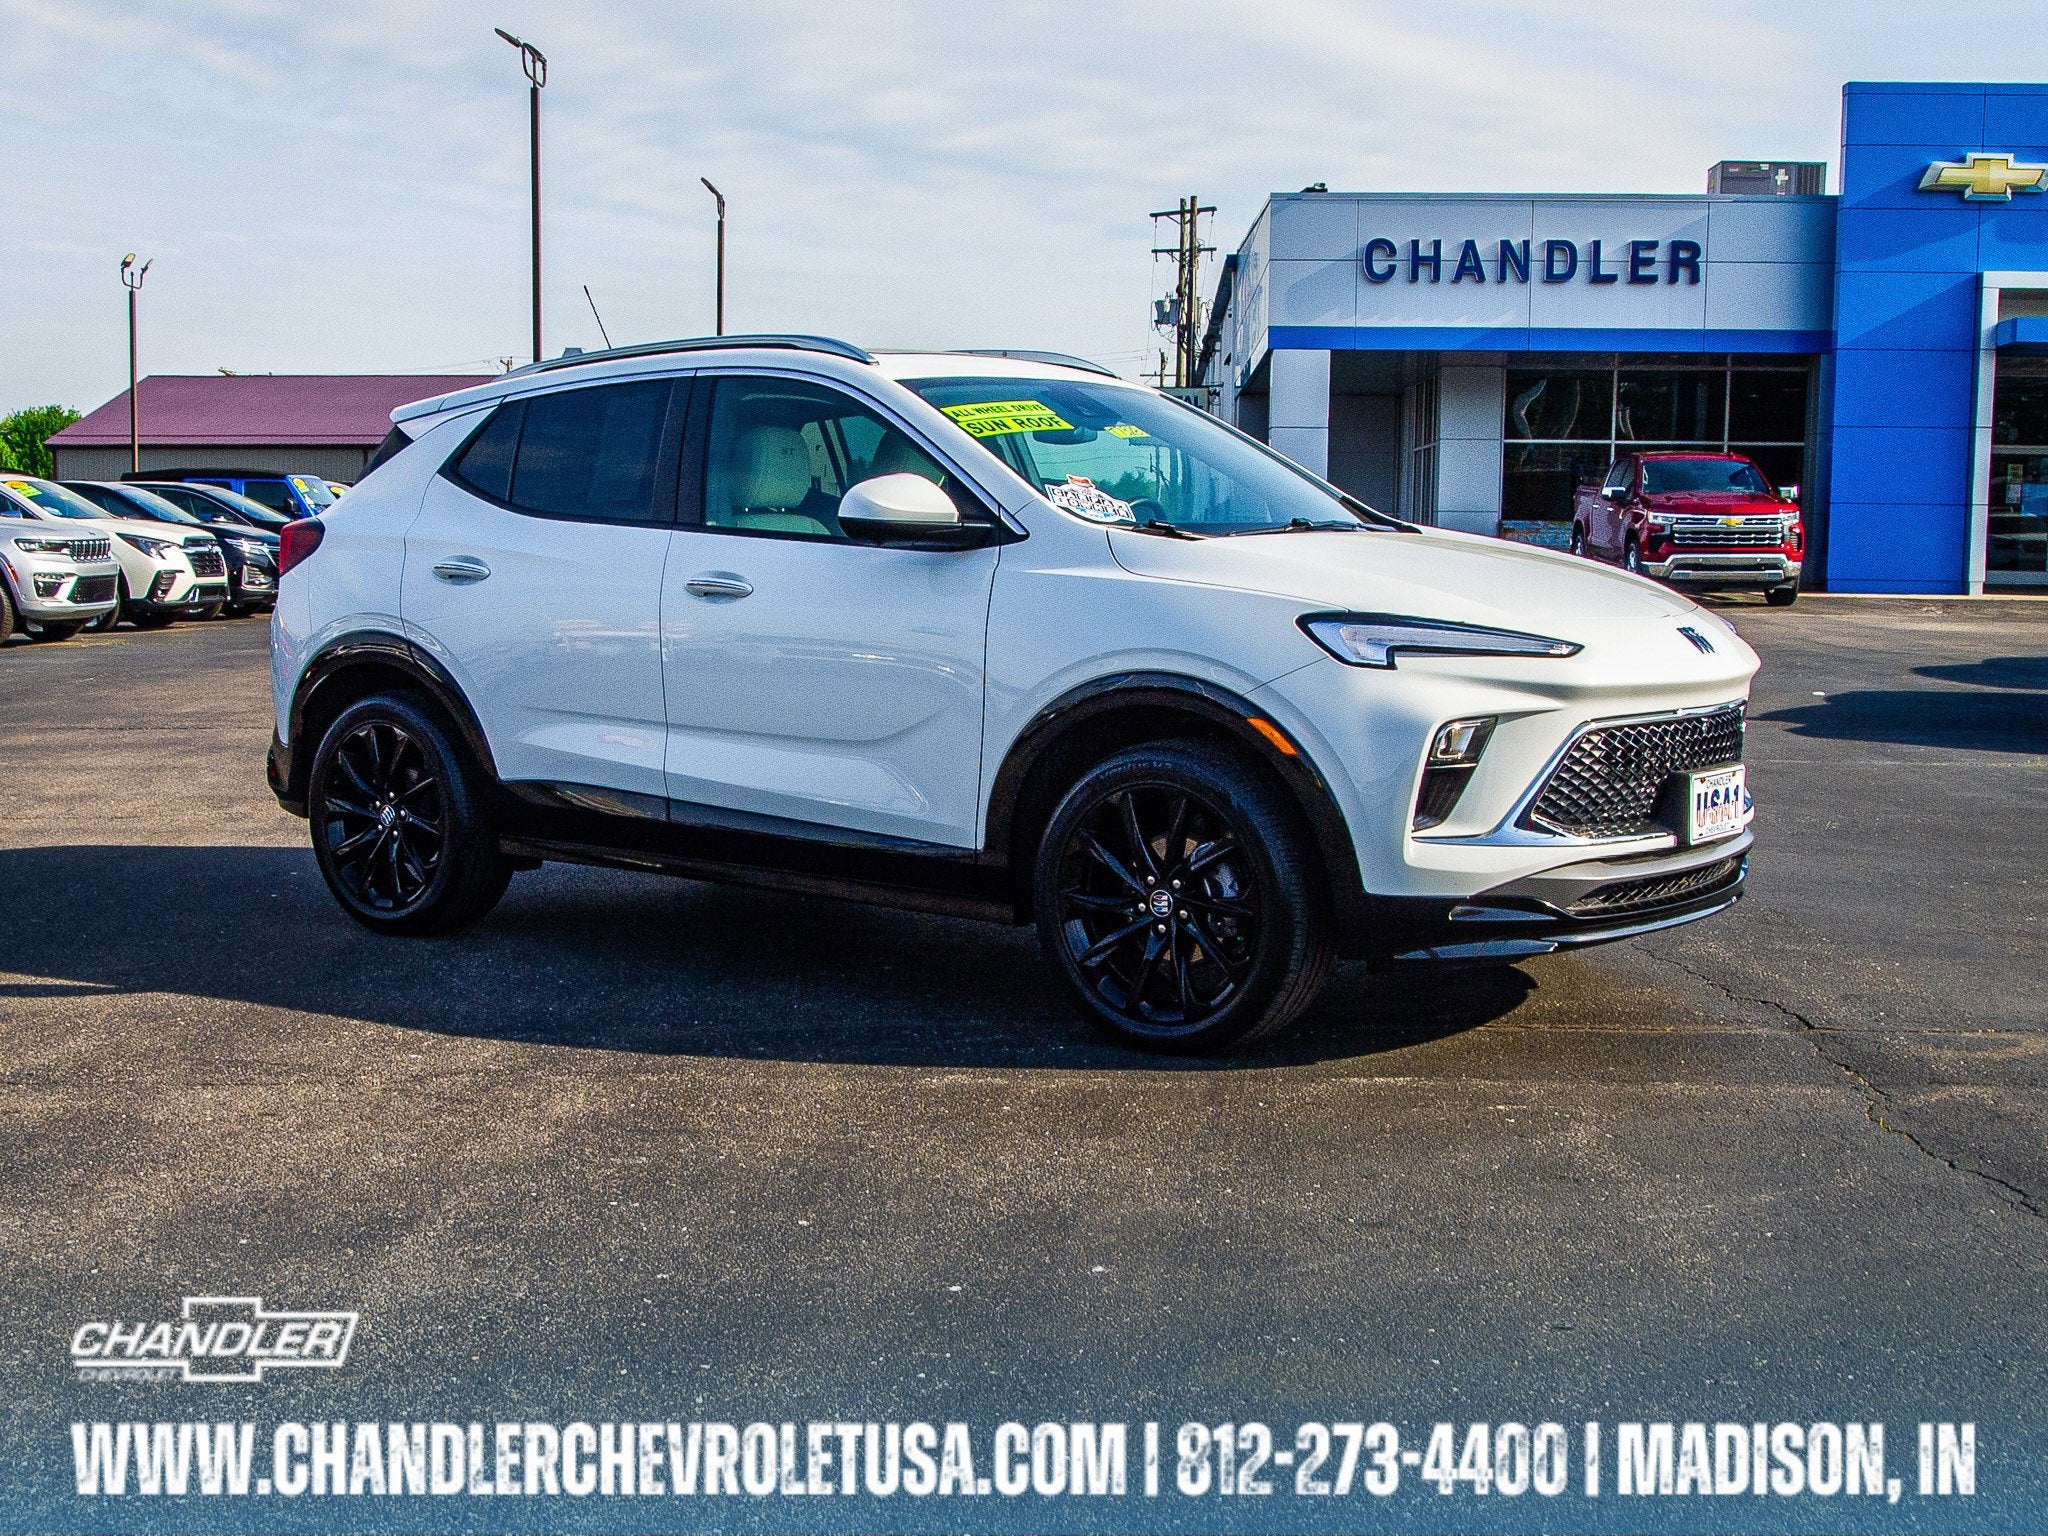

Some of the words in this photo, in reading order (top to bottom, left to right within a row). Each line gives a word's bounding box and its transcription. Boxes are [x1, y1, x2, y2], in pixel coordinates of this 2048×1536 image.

[1363, 237, 1702, 285] CHANDLER
[951, 408, 975, 418] ALL
[974, 404, 1013, 415] WHEEL
[1010, 403, 1047, 412] DRIVE
[965, 420, 1012, 435] SUN
[1011, 416, 1063, 429] ROOF
